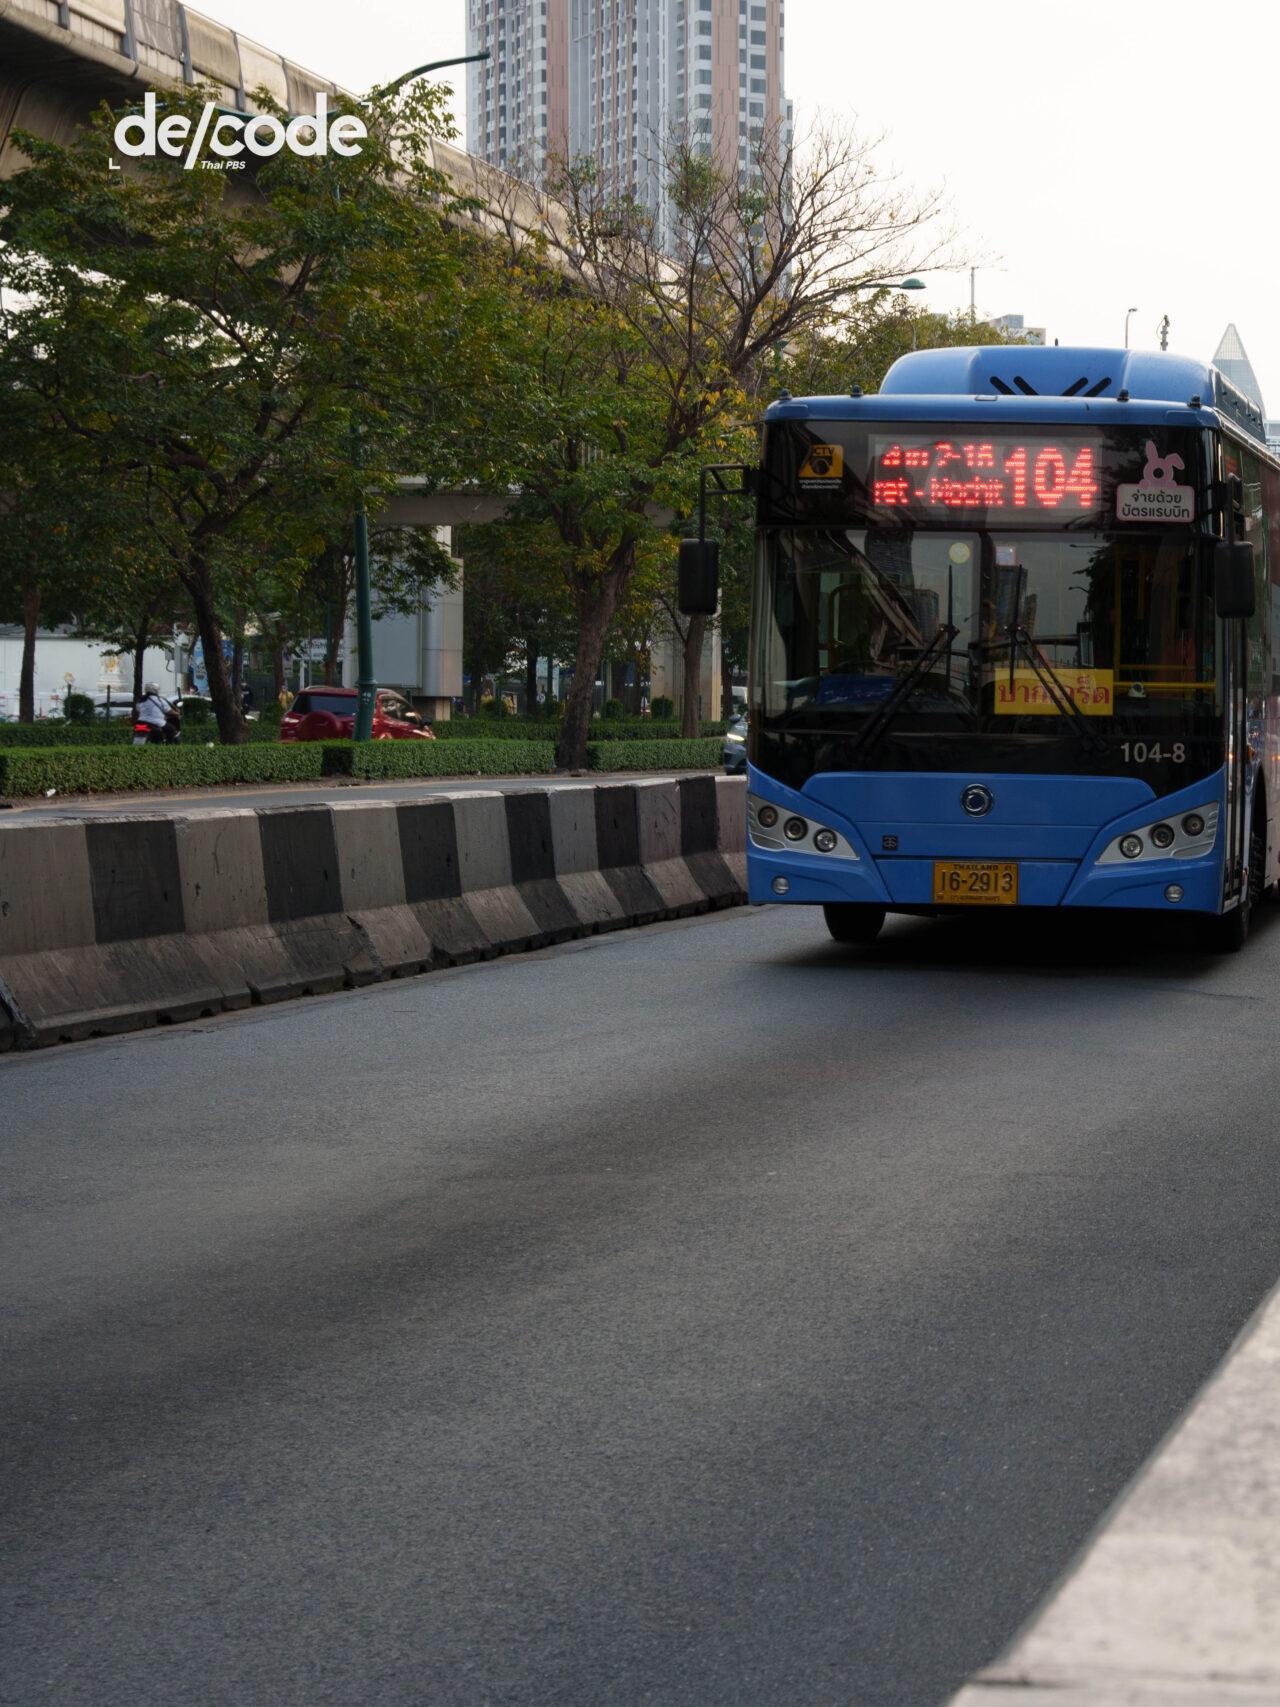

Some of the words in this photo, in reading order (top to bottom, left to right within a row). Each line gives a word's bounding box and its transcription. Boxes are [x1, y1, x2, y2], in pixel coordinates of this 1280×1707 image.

[1005, 447, 1098, 506] 104
[1131, 489, 1182, 504] จ่ายด้วย
[1122, 503, 1190, 518] บัตรแรบบิท
[1120, 742, 1186, 763] 104-8
[941, 871, 1013, 892] 16-2913
